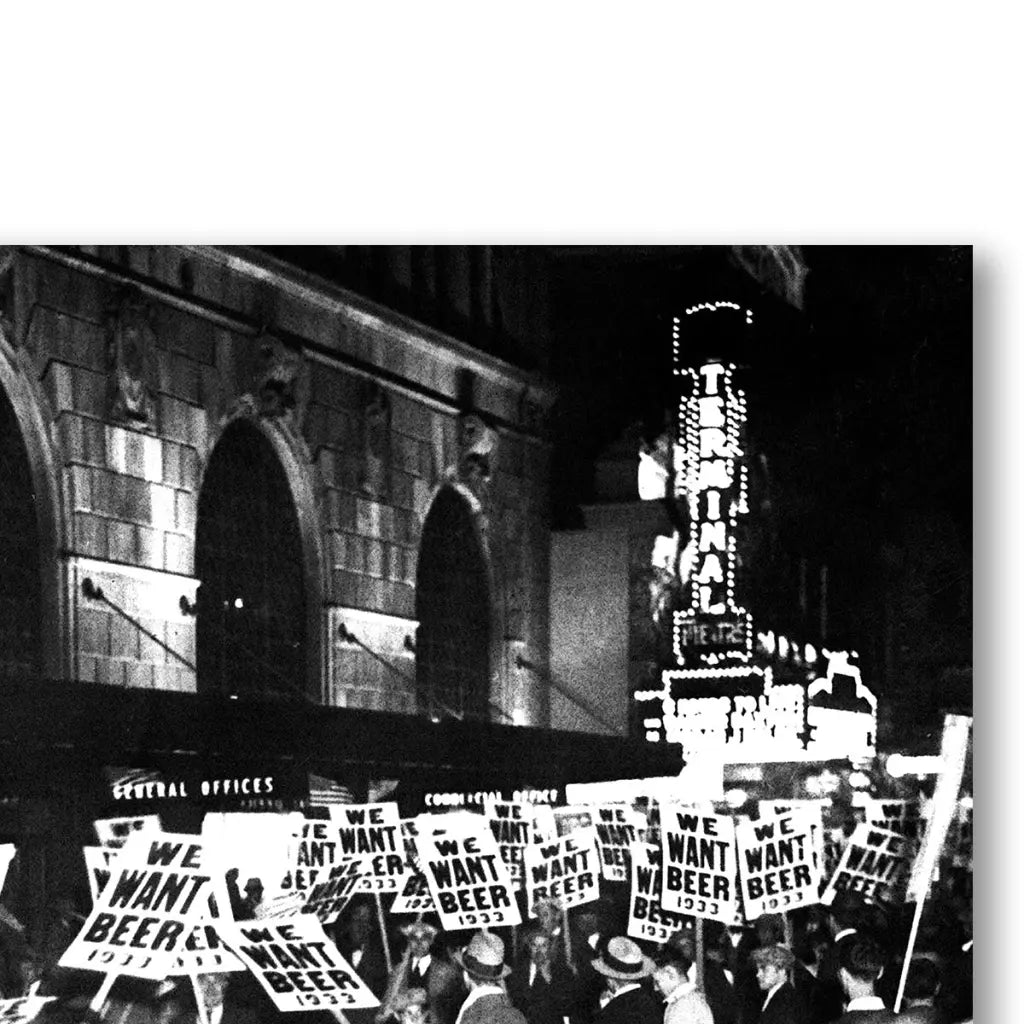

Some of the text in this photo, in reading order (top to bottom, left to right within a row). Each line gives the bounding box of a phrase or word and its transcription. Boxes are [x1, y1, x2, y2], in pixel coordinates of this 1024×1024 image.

[697, 363, 731, 615] TERMINAL
[201, 776, 273, 797] OFFICES
[345, 807, 384, 825] WE
[494, 804, 522, 819] WE
[599, 808, 626, 823] WE
[676, 813, 718, 836] WE
[338, 825, 396, 854] WANT
[754, 817, 794, 841] WE
[147, 841, 202, 869] WE
[297, 841, 336, 867] ANT
[434, 837, 481, 856] WE
[540, 839, 578, 859] WE
[667, 832, 729, 872] WANT
[745, 834, 806, 873] WANT
[429, 855, 498, 889] WANT
[532, 848, 590, 884] WANT
[108, 869, 211, 915] WANT
[667, 865, 730, 901] BEER
[747, 864, 811, 900] BEER
[438, 885, 511, 914] BEER
[677, 896, 719, 915] 1933
[83, 912, 184, 952] BEER
[458, 912, 504, 926] 1933
[240, 924, 303, 943] WE
[239, 942, 336, 970] WANT
[262, 969, 360, 994] BEER
